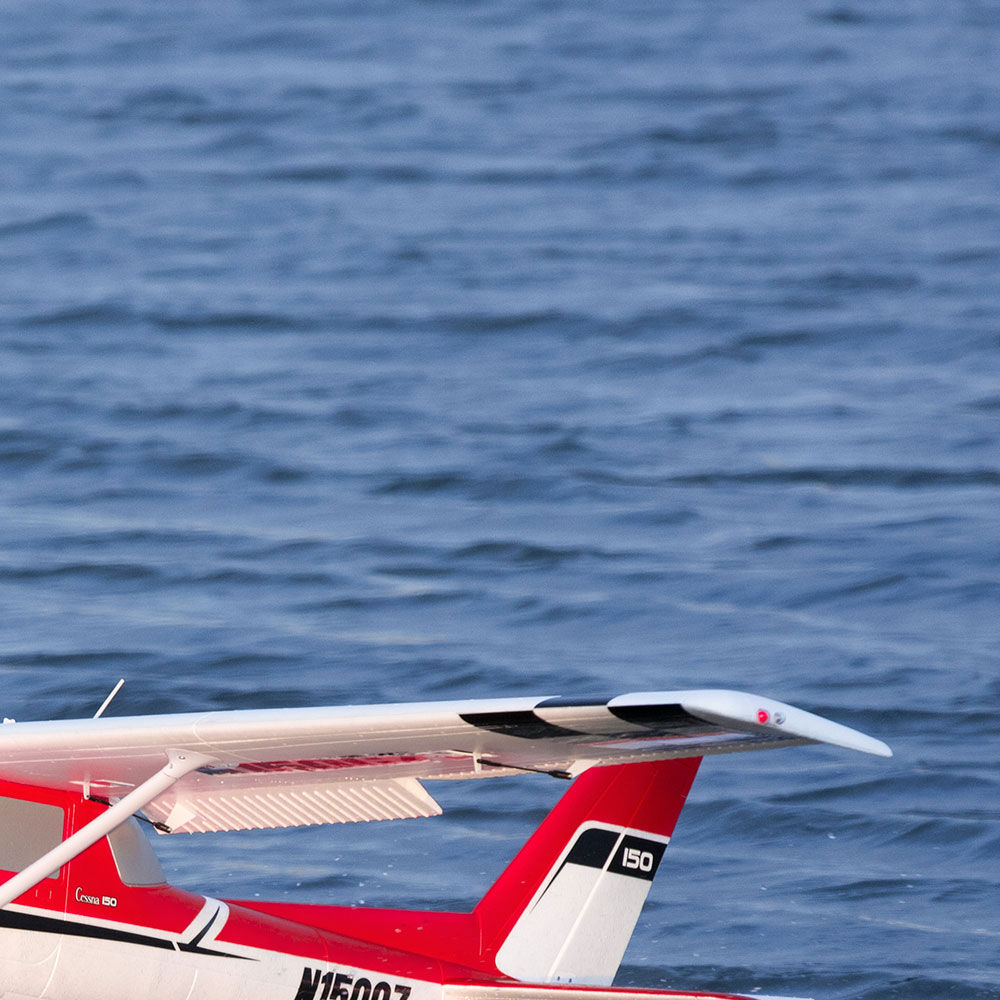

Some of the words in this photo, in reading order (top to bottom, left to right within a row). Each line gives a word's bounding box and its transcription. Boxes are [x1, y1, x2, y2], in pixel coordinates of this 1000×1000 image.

[622, 847, 654, 872] 150
[75, 886, 100, 905] Cessna
[102, 895, 118, 907] 150
